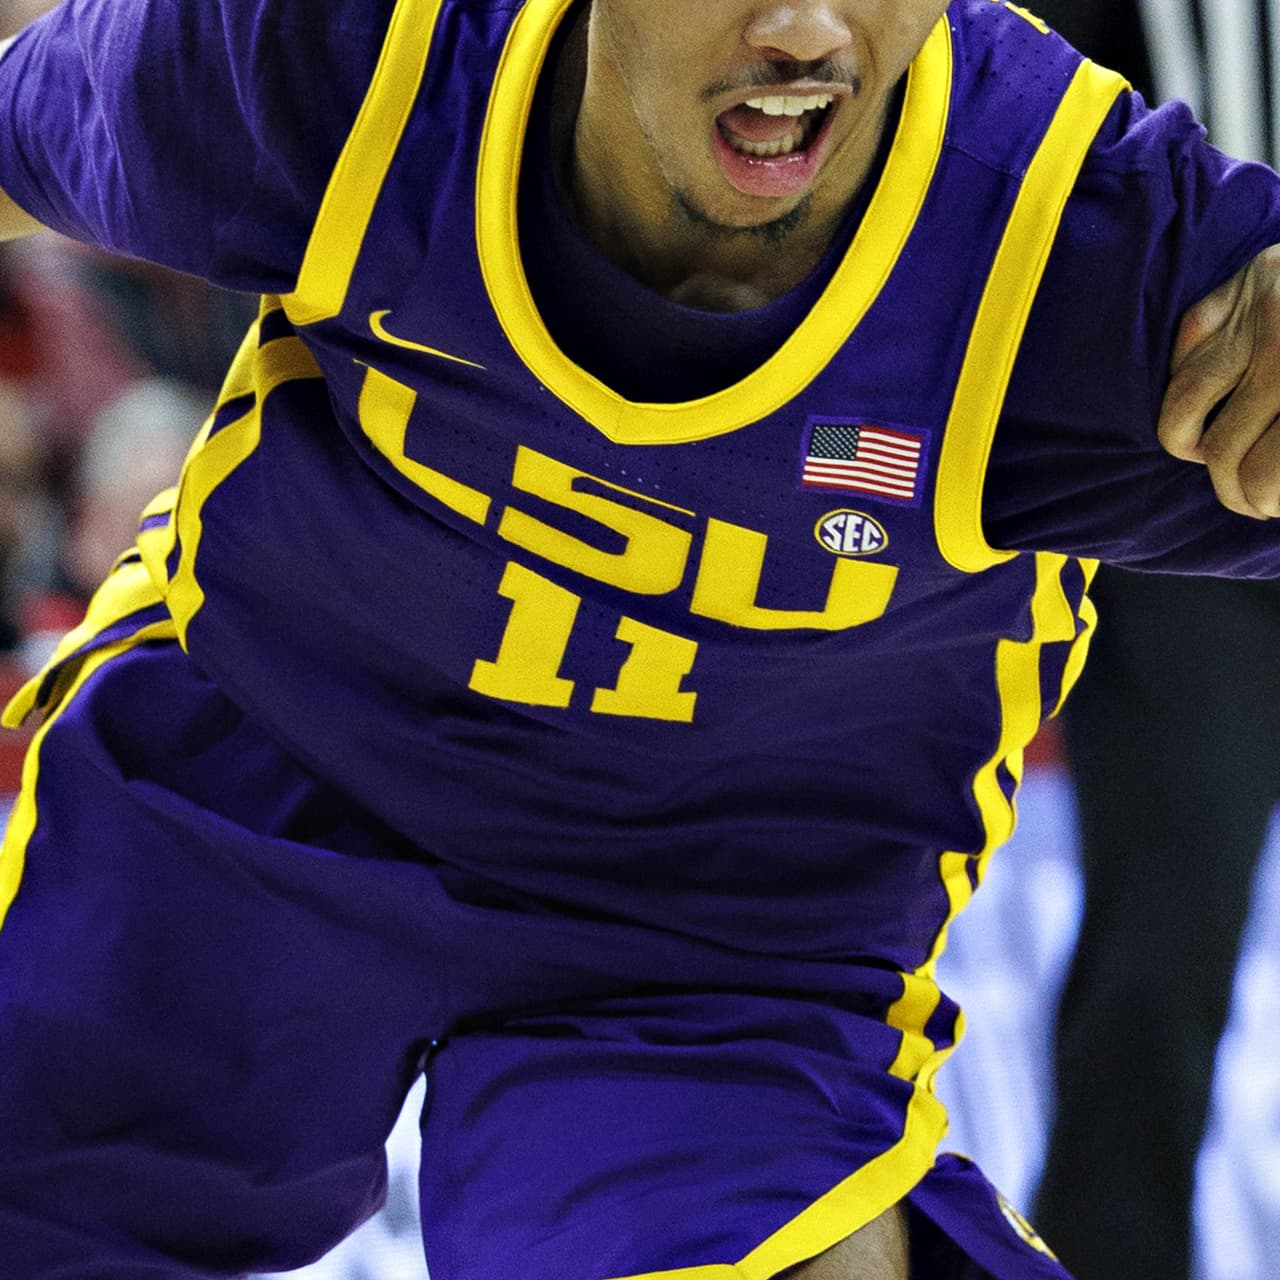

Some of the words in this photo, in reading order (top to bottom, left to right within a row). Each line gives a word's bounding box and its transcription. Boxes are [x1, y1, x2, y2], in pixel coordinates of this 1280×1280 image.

[354, 359, 899, 631] LSU
[822, 513, 882, 553] SEC
[468, 561, 698, 723] 11
